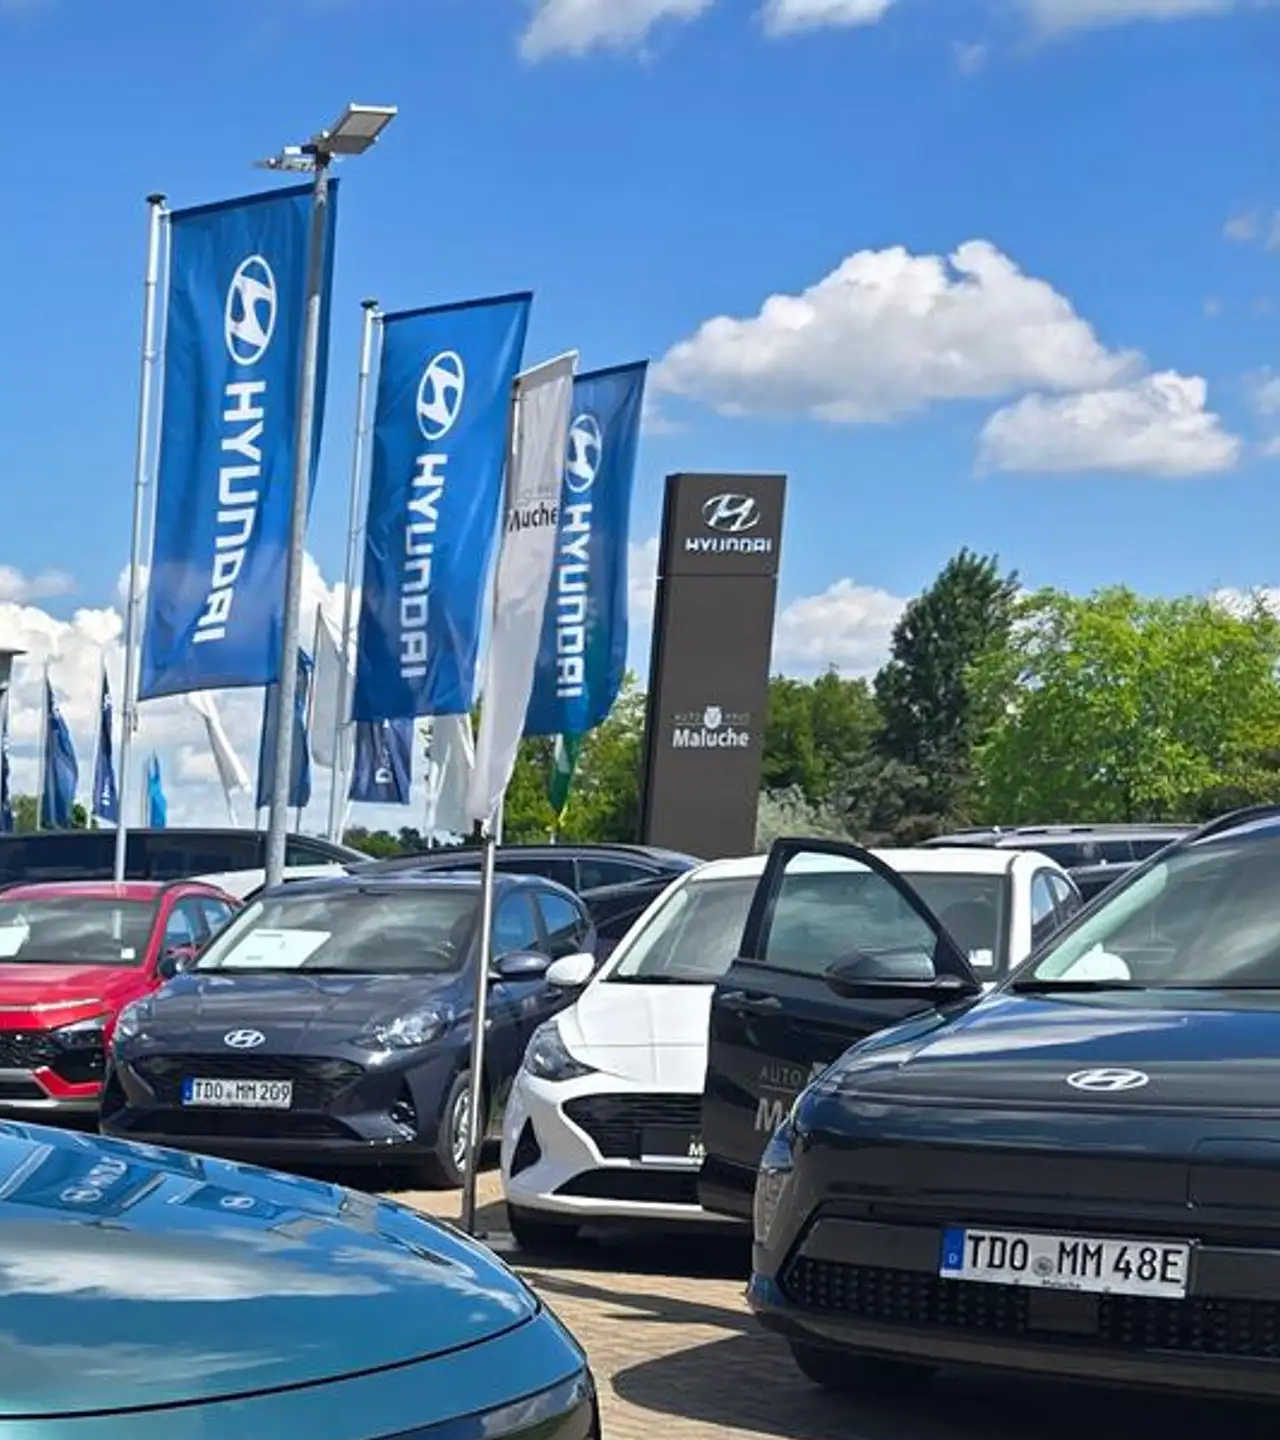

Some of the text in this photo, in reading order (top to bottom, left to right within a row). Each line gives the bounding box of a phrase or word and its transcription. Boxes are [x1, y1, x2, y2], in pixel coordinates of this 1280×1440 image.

[192, 380, 266, 643] HYUNDAI
[400, 453, 448, 678] HYUNDAI
[685, 537, 772, 552] HYUNDAI
[556, 503, 593, 697] HYUNDAI
[672, 727, 750, 748] Maluche
[196, 1082, 223, 1099] TDO
[260, 1085, 290, 1102] 209
[968, 1233, 1184, 1284] TDO MM 48E
